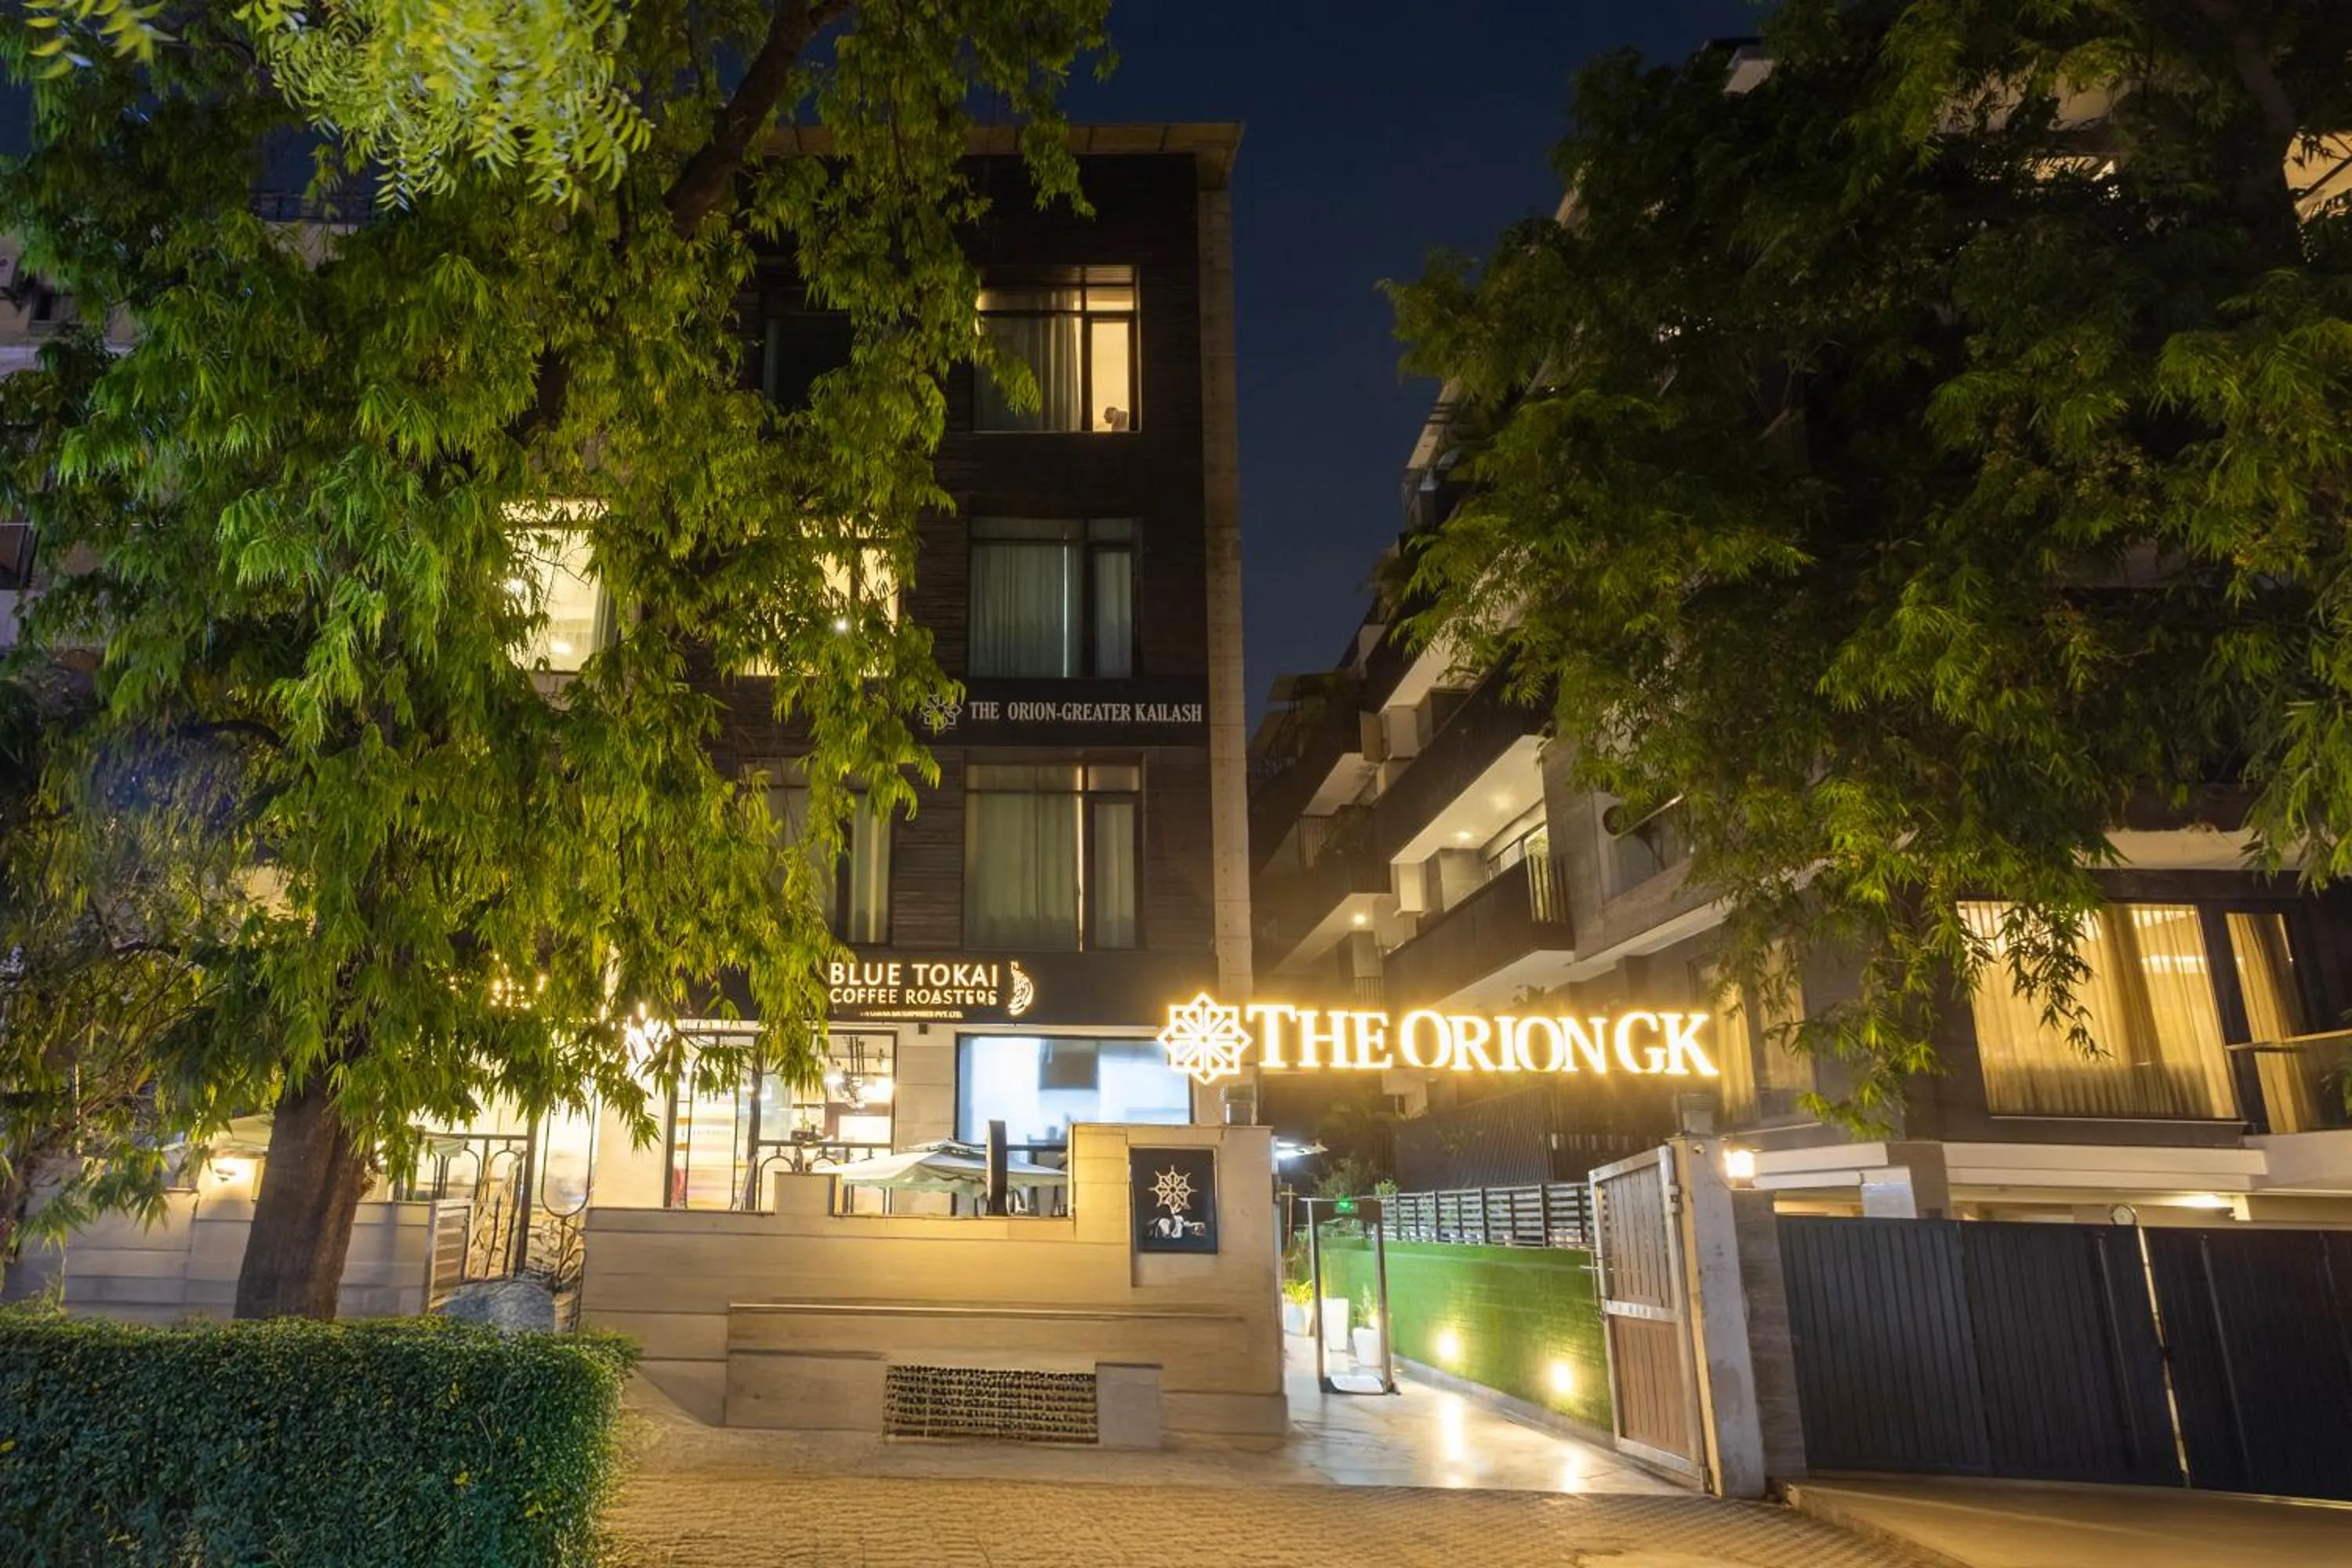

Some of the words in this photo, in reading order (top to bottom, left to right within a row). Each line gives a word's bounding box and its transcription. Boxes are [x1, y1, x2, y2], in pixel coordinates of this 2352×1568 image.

[969, 702, 1000, 720] THE
[1135, 702, 1203, 722] KAILASH
[830, 962, 902, 985] BLUE
[911, 963, 998, 987] TOKAI
[829, 987, 898, 1004] COFFEE
[906, 989, 998, 1006] ROASTERS
[1246, 1004, 1393, 1069] THE
[1400, 1009, 1610, 1075] ORION
[1614, 1011, 1719, 1077] GK
